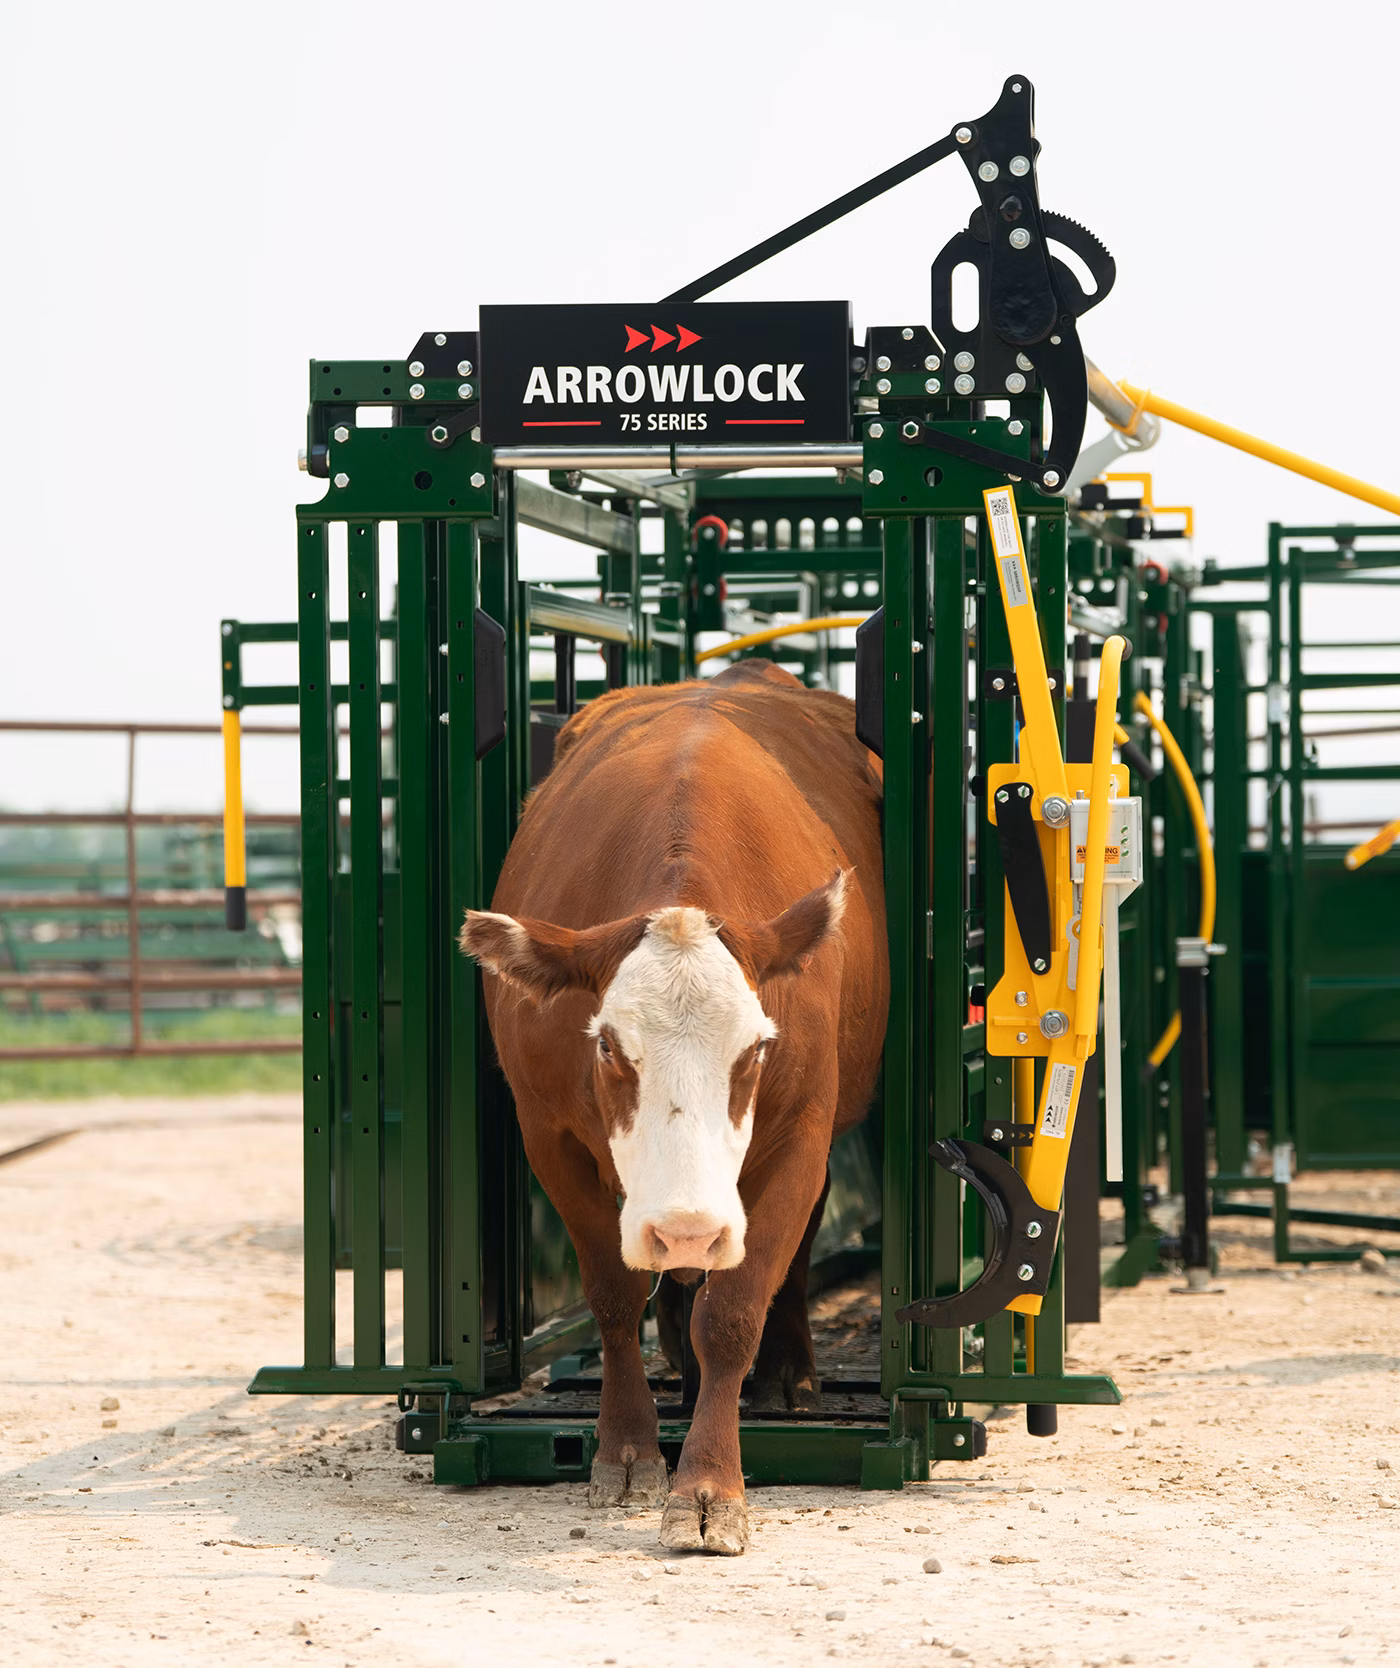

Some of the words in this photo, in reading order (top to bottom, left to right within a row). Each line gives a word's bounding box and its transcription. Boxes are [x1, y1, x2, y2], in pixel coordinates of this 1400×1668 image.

[522, 364, 805, 404] ARROWLOCK
[620, 413, 641, 431] 75
[647, 413, 708, 431] SERIES
